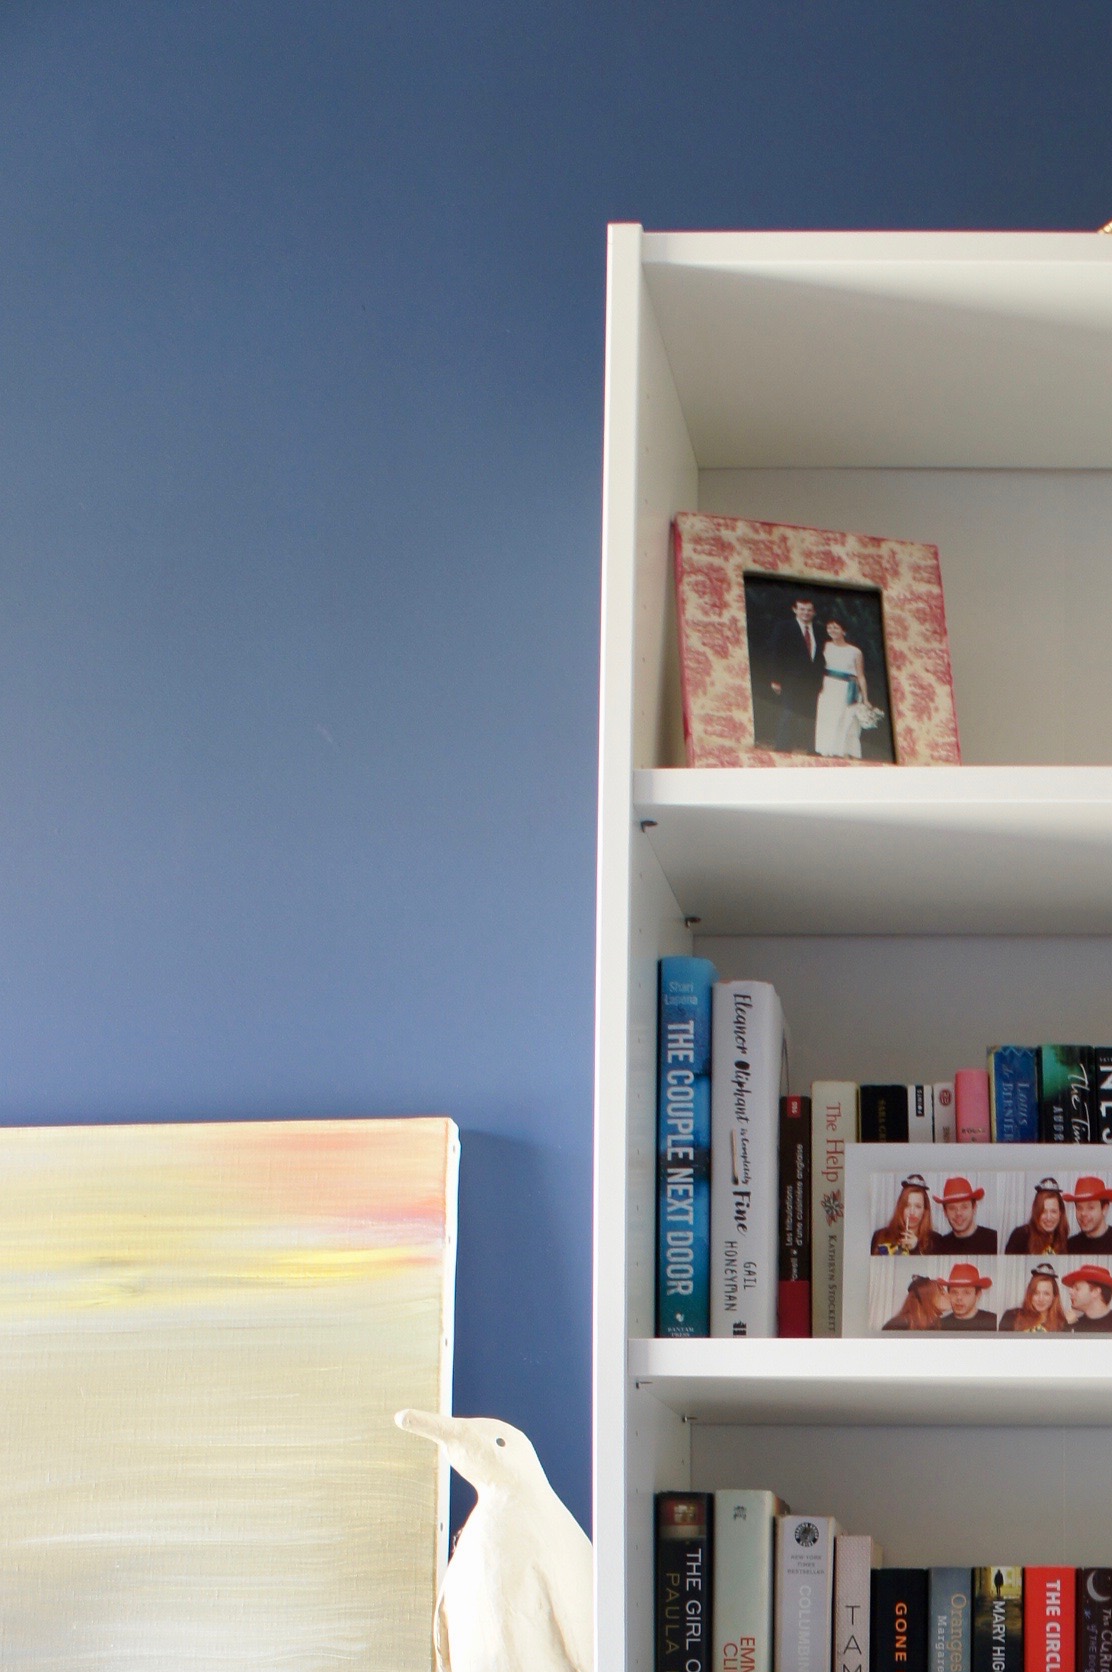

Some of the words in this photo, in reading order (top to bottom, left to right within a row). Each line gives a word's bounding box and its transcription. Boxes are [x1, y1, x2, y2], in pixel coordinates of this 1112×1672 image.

[668, 1021, 694, 1063] THE
[733, 992, 752, 1055] Eleanor
[667, 1069, 694, 1161] COUPLE
[733, 1060, 751, 1124] Oliphant
[826, 1102, 842, 1131] The
[822, 1140, 845, 1182] Help
[668, 1168, 694, 1226] NEXT
[732, 1190, 752, 1236] Fine
[666, 1231, 693, 1296] DOOR
[723, 1241, 738, 1313] HONEYMAN
[743, 1262, 758, 1291] GAIL
[685, 1548, 702, 1592] THE
[1045, 1578, 1061, 1612] THE
[685, 1599, 702, 1651] GIRL
[895, 1602, 908, 1661] GONE
